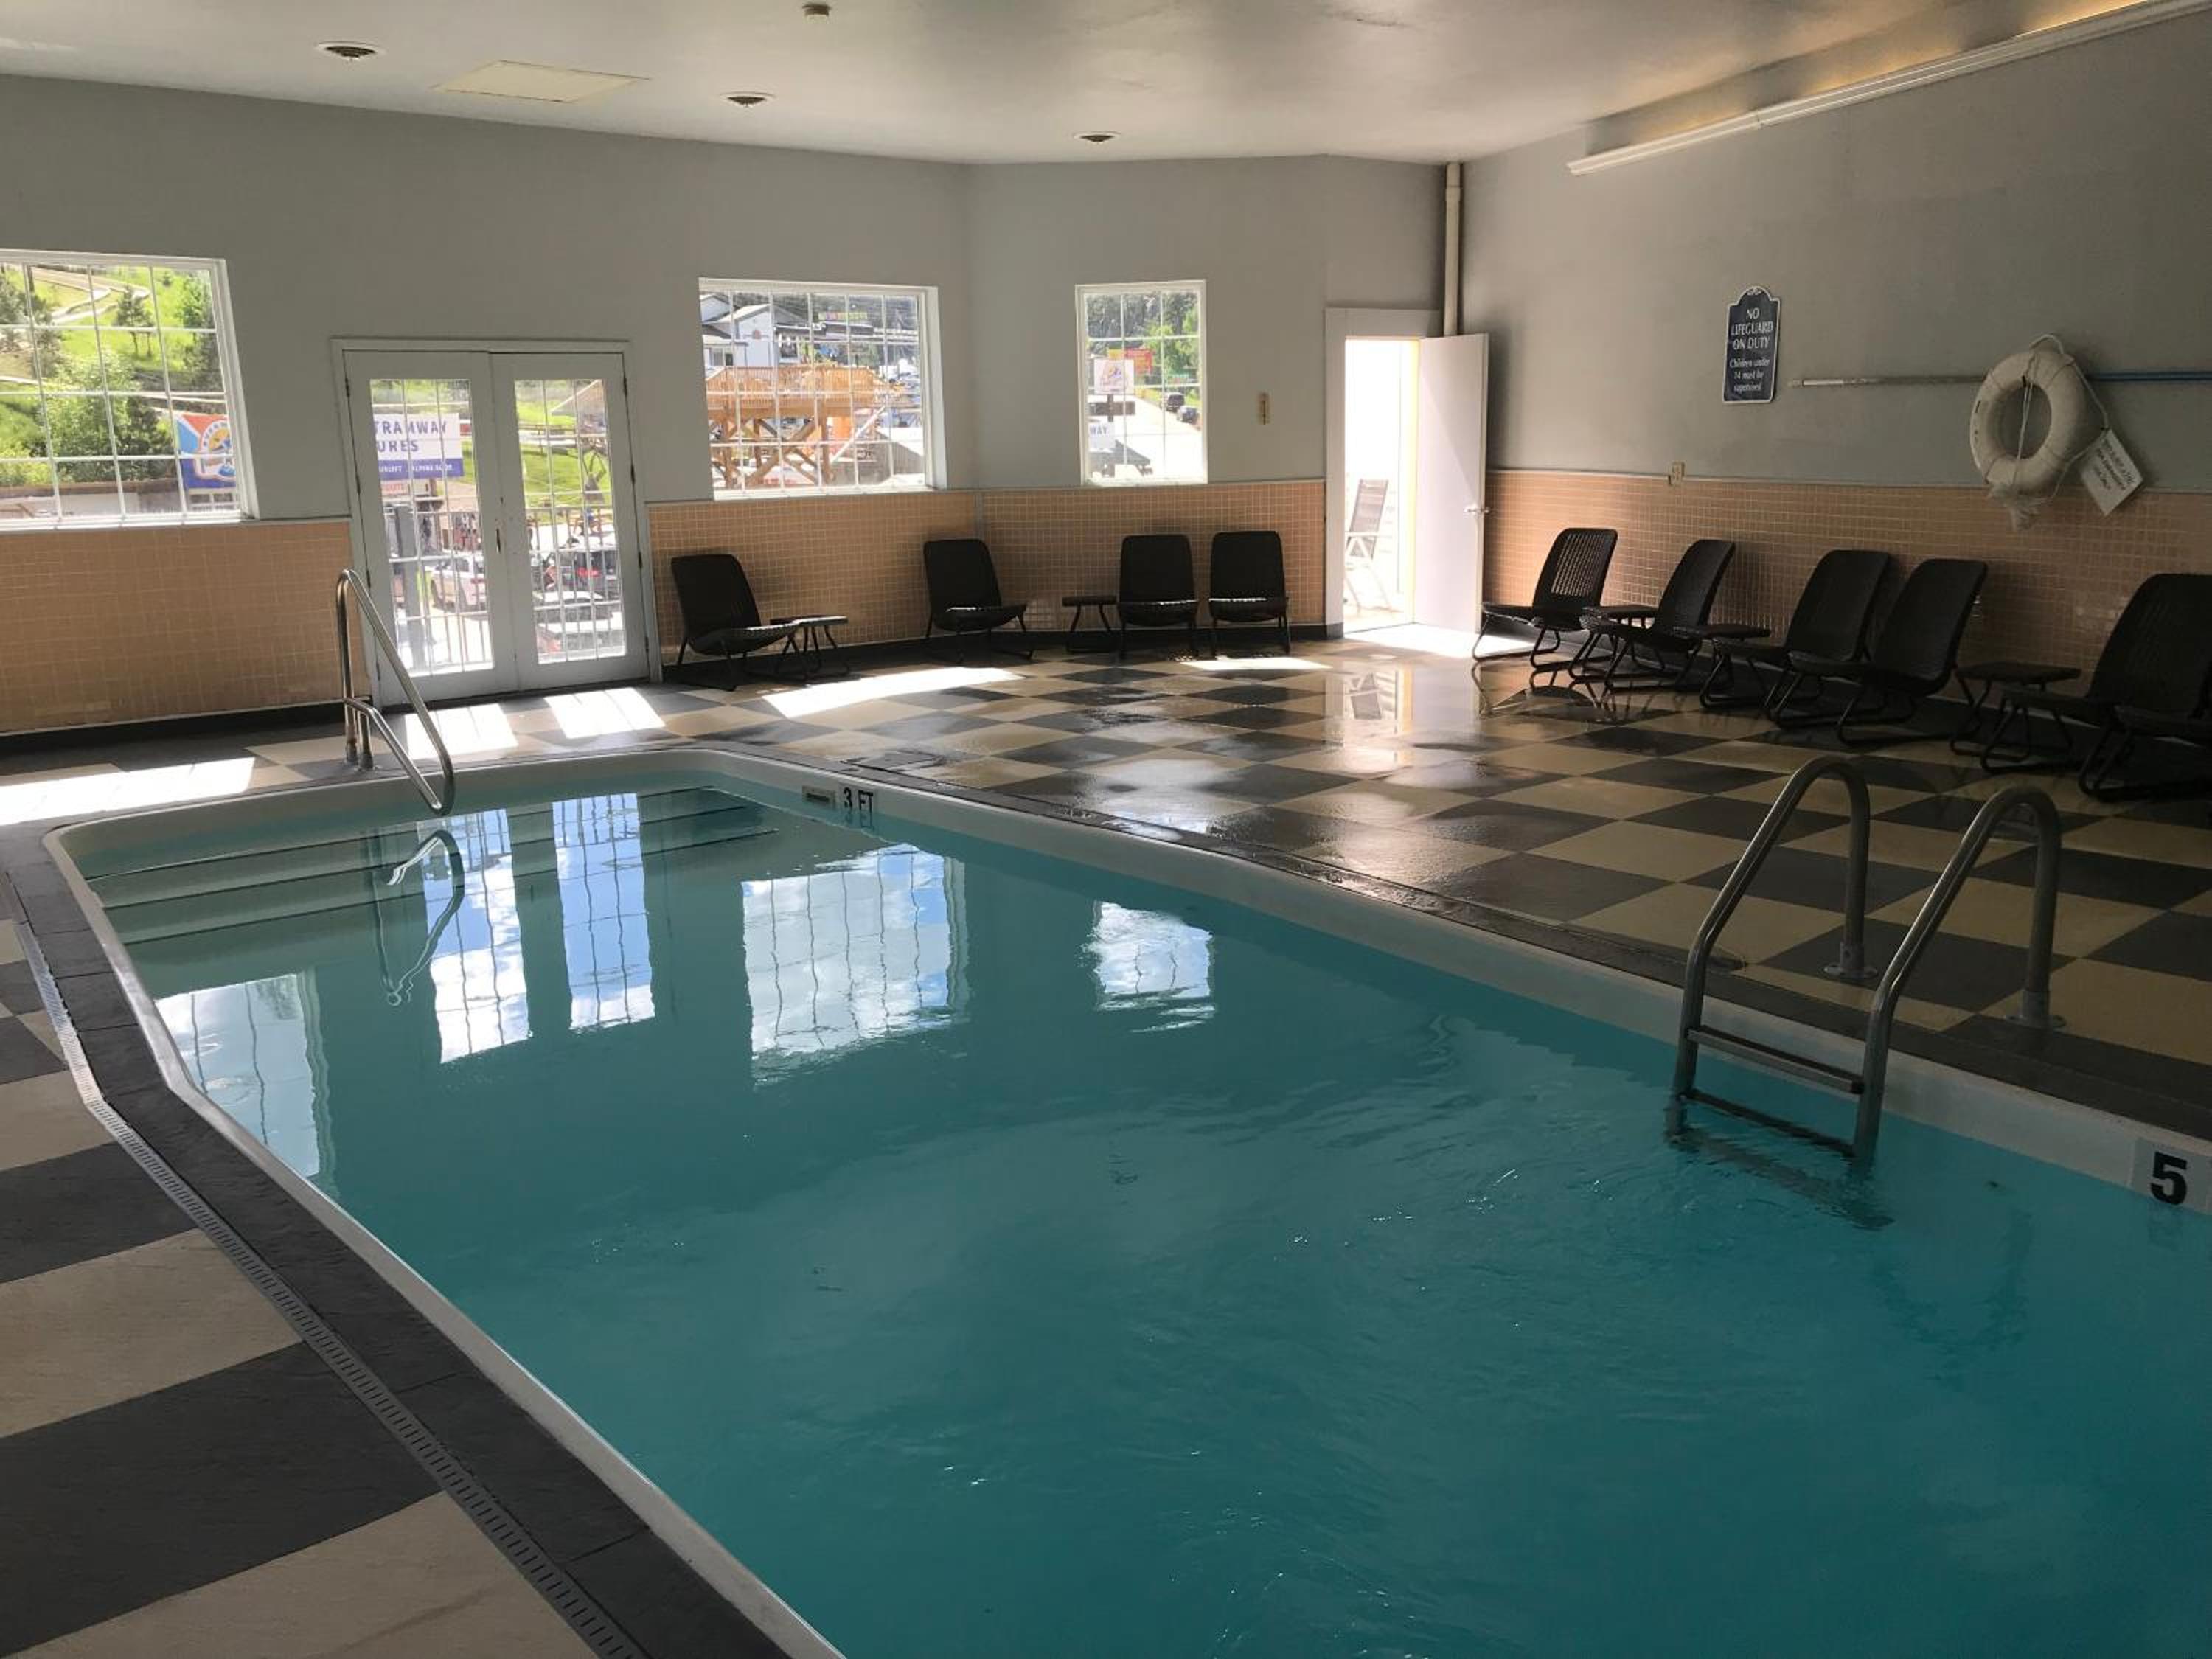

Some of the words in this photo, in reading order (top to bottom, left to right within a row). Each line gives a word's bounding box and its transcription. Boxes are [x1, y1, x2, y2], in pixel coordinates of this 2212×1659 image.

[1746, 307, 1760, 319] NO
[1731, 321, 1773, 335] LIFEGUARD
[1733, 338, 1745, 350] ON
[1747, 335, 1770, 349] DUTY
[843, 787, 852, 810] 3
[858, 790, 874, 813] FT
[2150, 1152, 2188, 1206] 5
